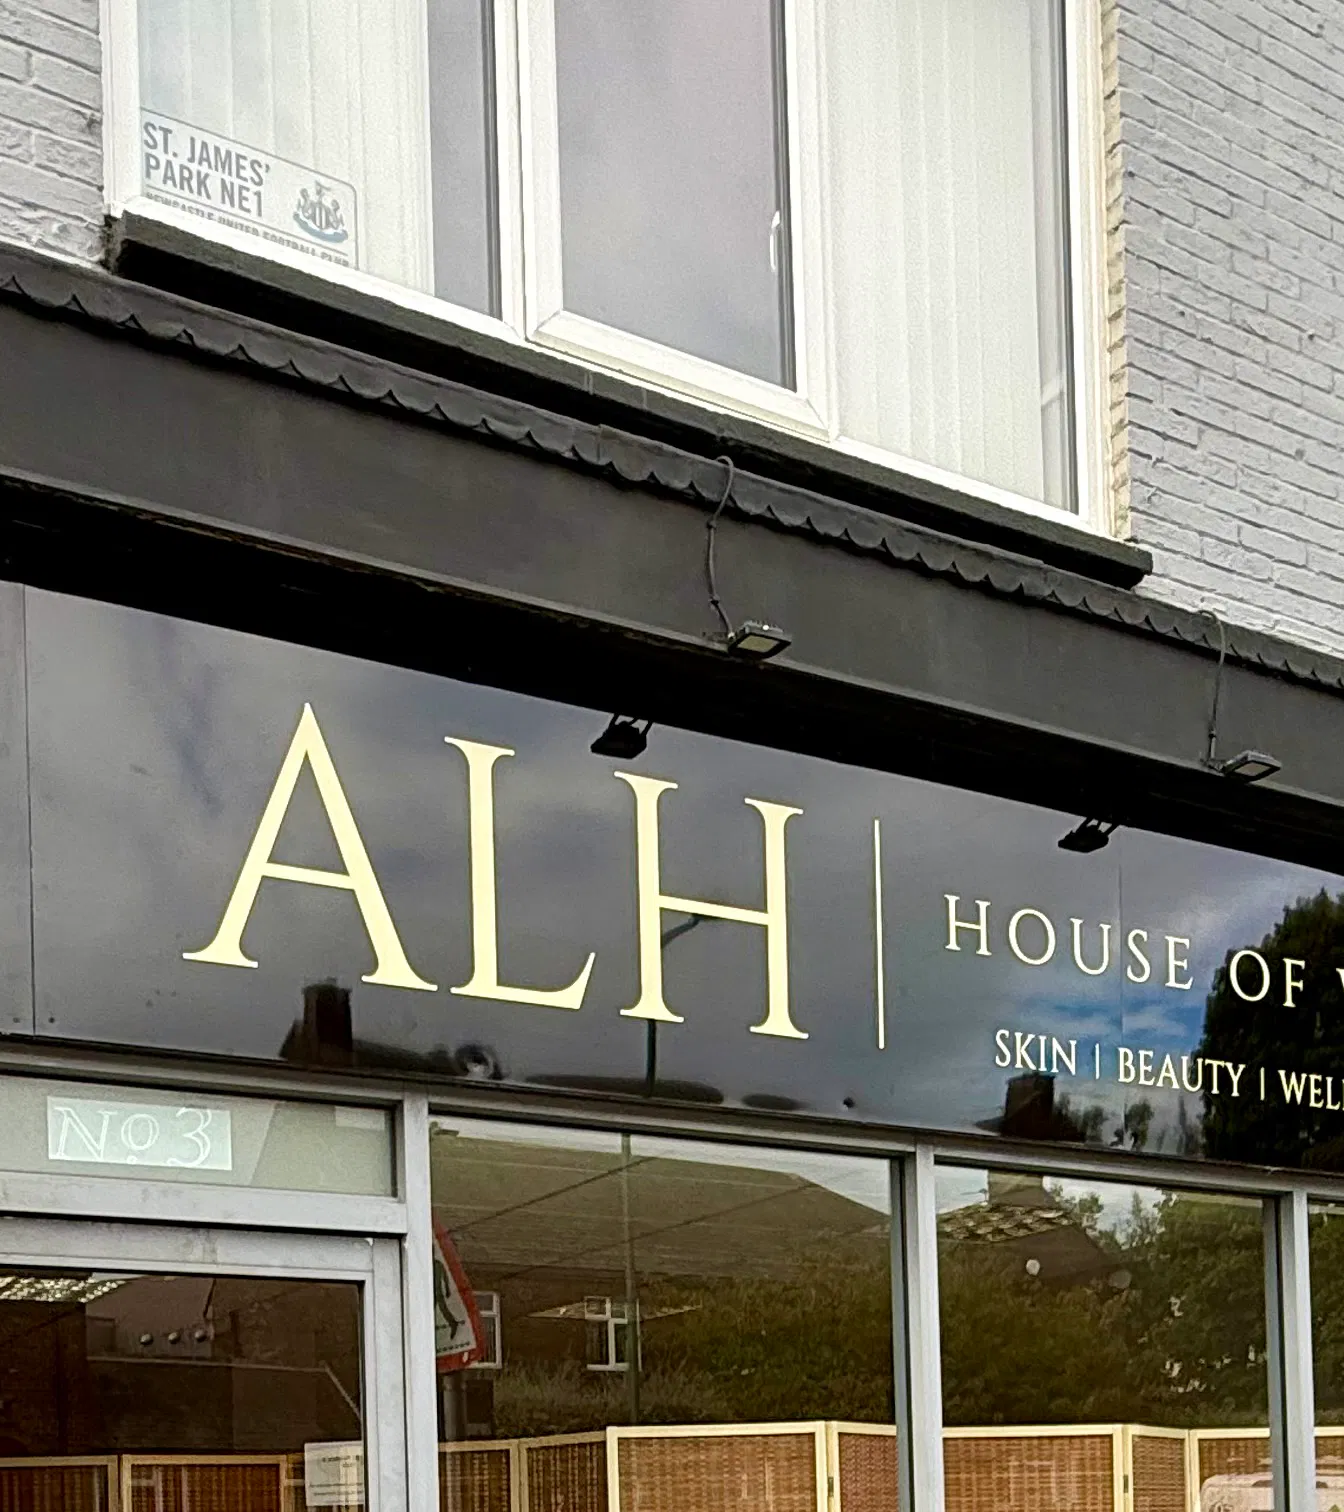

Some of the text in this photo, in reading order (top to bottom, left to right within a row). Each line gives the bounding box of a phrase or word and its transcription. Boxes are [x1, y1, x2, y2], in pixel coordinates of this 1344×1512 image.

[143, 121, 271, 187] ST. JAMES'
[144, 151, 263, 217] PARK NE1
[182, 701, 810, 1040] ALH
[943, 893, 1195, 990] HOUSE
[1229, 948, 1307, 1008] OF
[994, 1028, 1078, 1077] SKIN
[1118, 1045, 1246, 1098] BEAUTY
